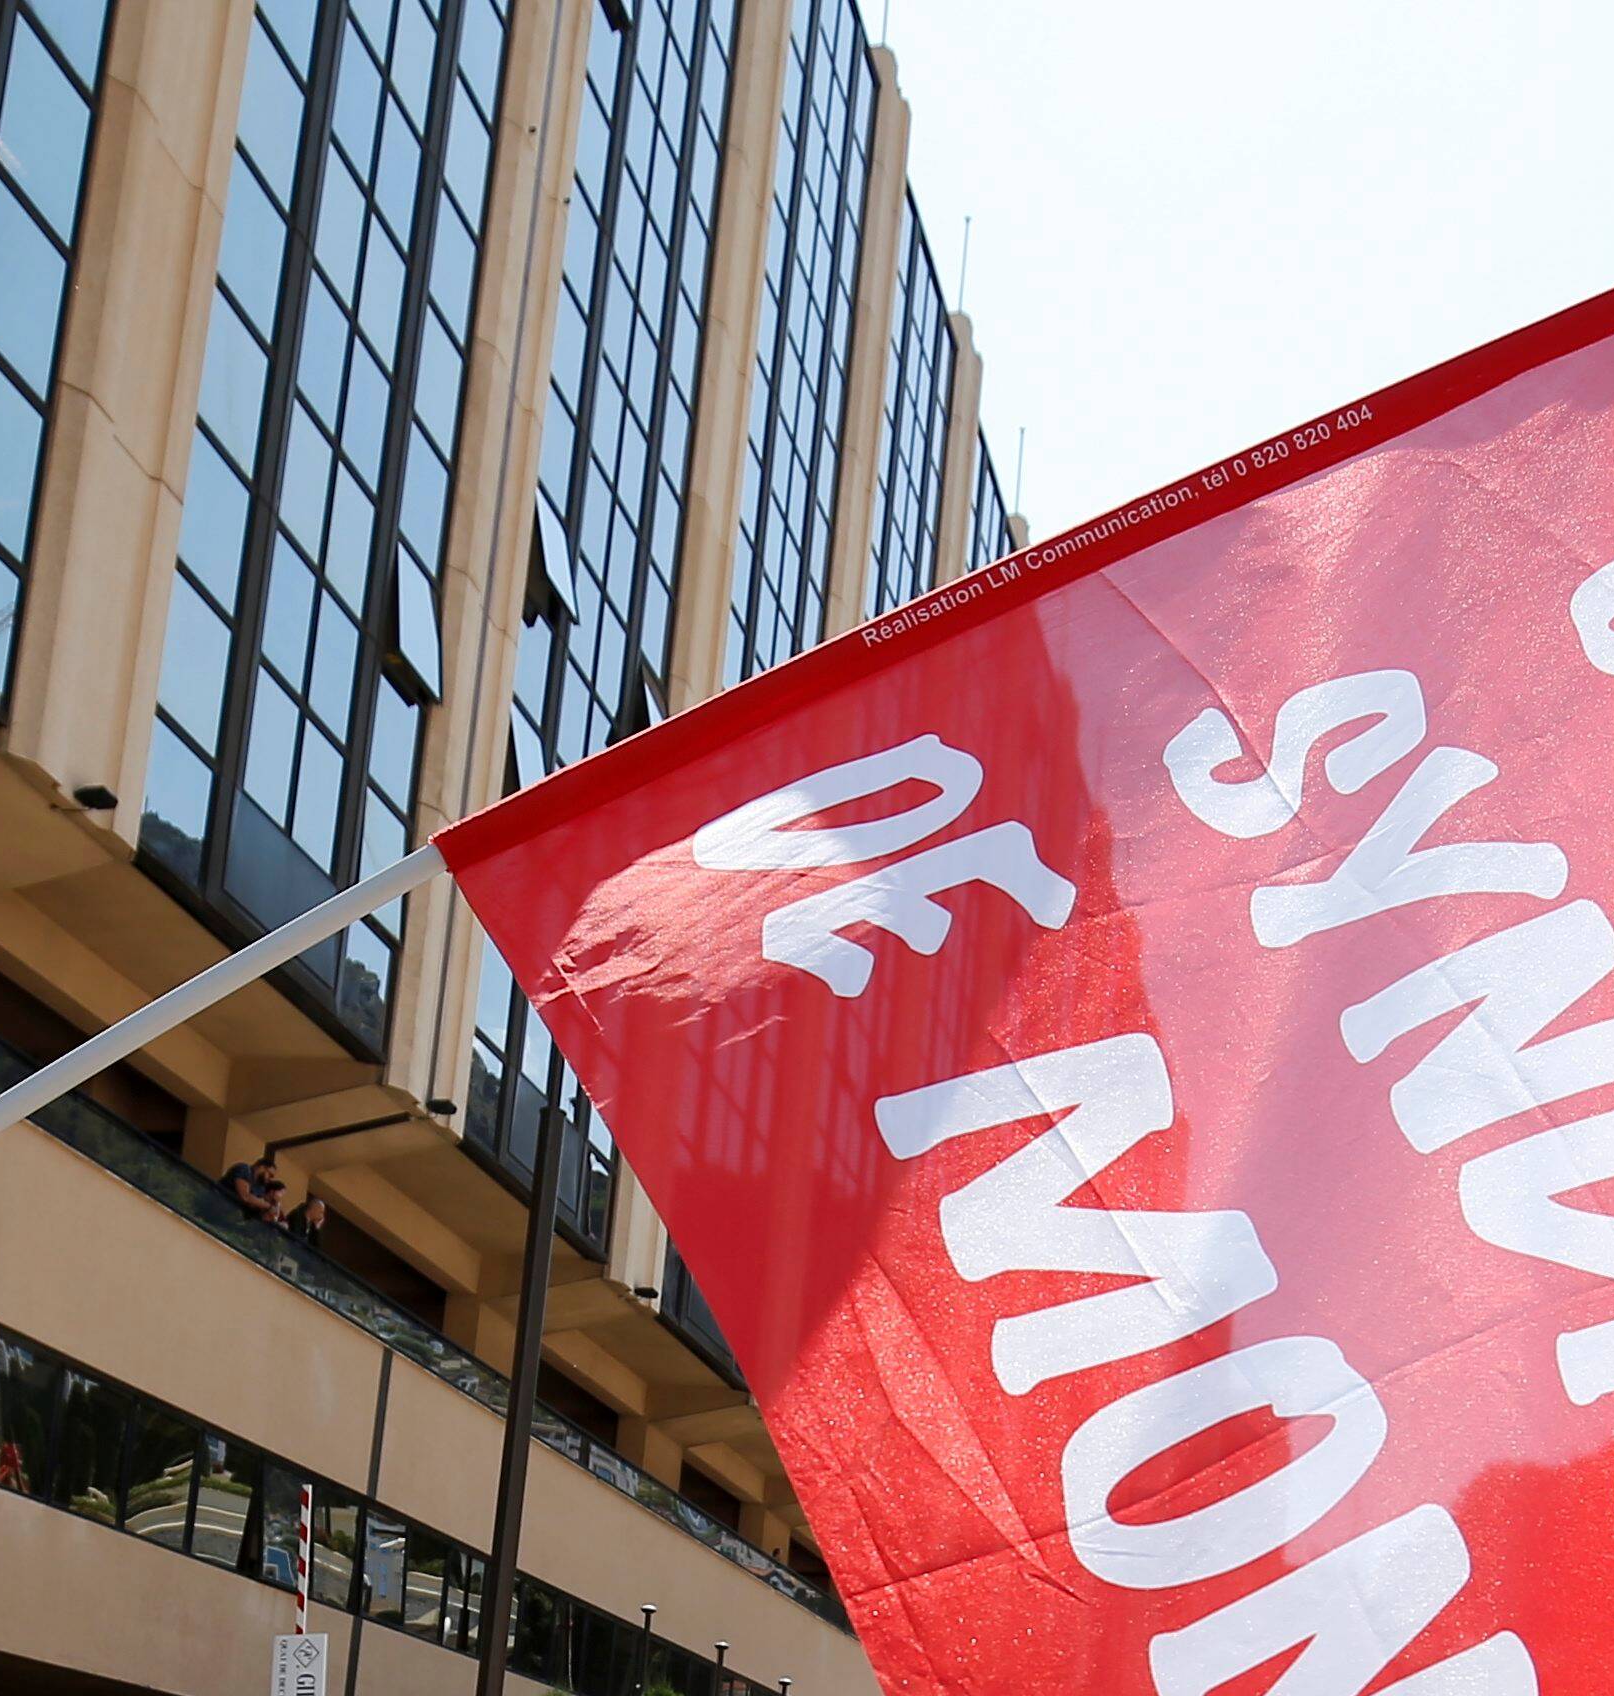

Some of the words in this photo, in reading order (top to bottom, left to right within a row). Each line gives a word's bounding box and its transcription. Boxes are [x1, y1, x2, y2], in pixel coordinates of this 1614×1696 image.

[861, 582, 984, 648] Réalisation
[985, 560, 1023, 590] LM
[1025, 484, 1200, 570] Communication,
[1201, 465, 1230, 492] tél
[1233, 458, 1248, 478] 0
[1252, 440, 1289, 470] 820
[1292, 422, 1331, 452] 820
[1336, 403, 1374, 432] 404
[692, 733, 1077, 999] DE
[278, 1663, 287, 1675] DE
